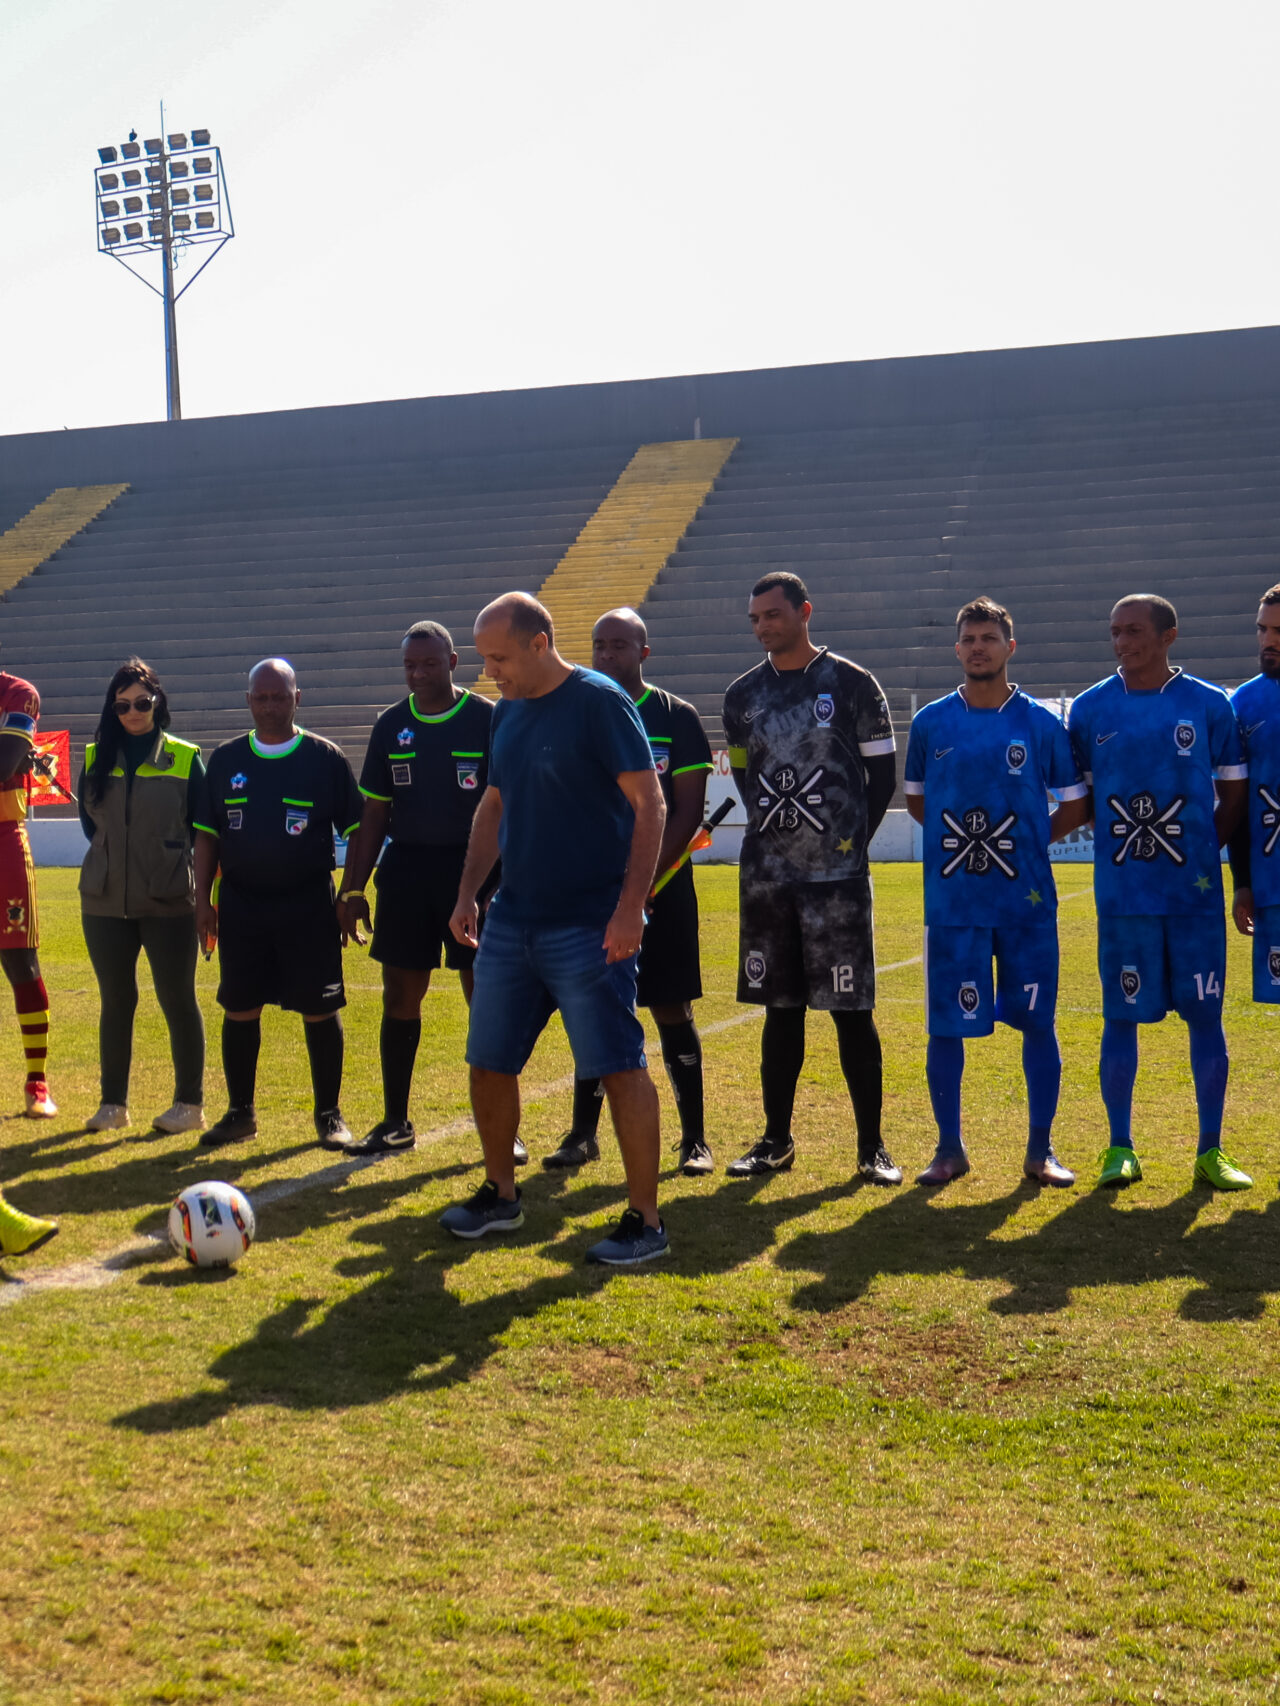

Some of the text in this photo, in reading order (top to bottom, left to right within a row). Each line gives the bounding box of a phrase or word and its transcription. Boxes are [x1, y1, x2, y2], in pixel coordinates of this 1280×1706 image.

[778, 807, 799, 829] 13
[1134, 836, 1156, 858] 13
[967, 851, 989, 872] 13
[831, 965, 854, 993] 12
[1193, 971, 1221, 1001] 14
[1024, 983, 1039, 1011] 7
